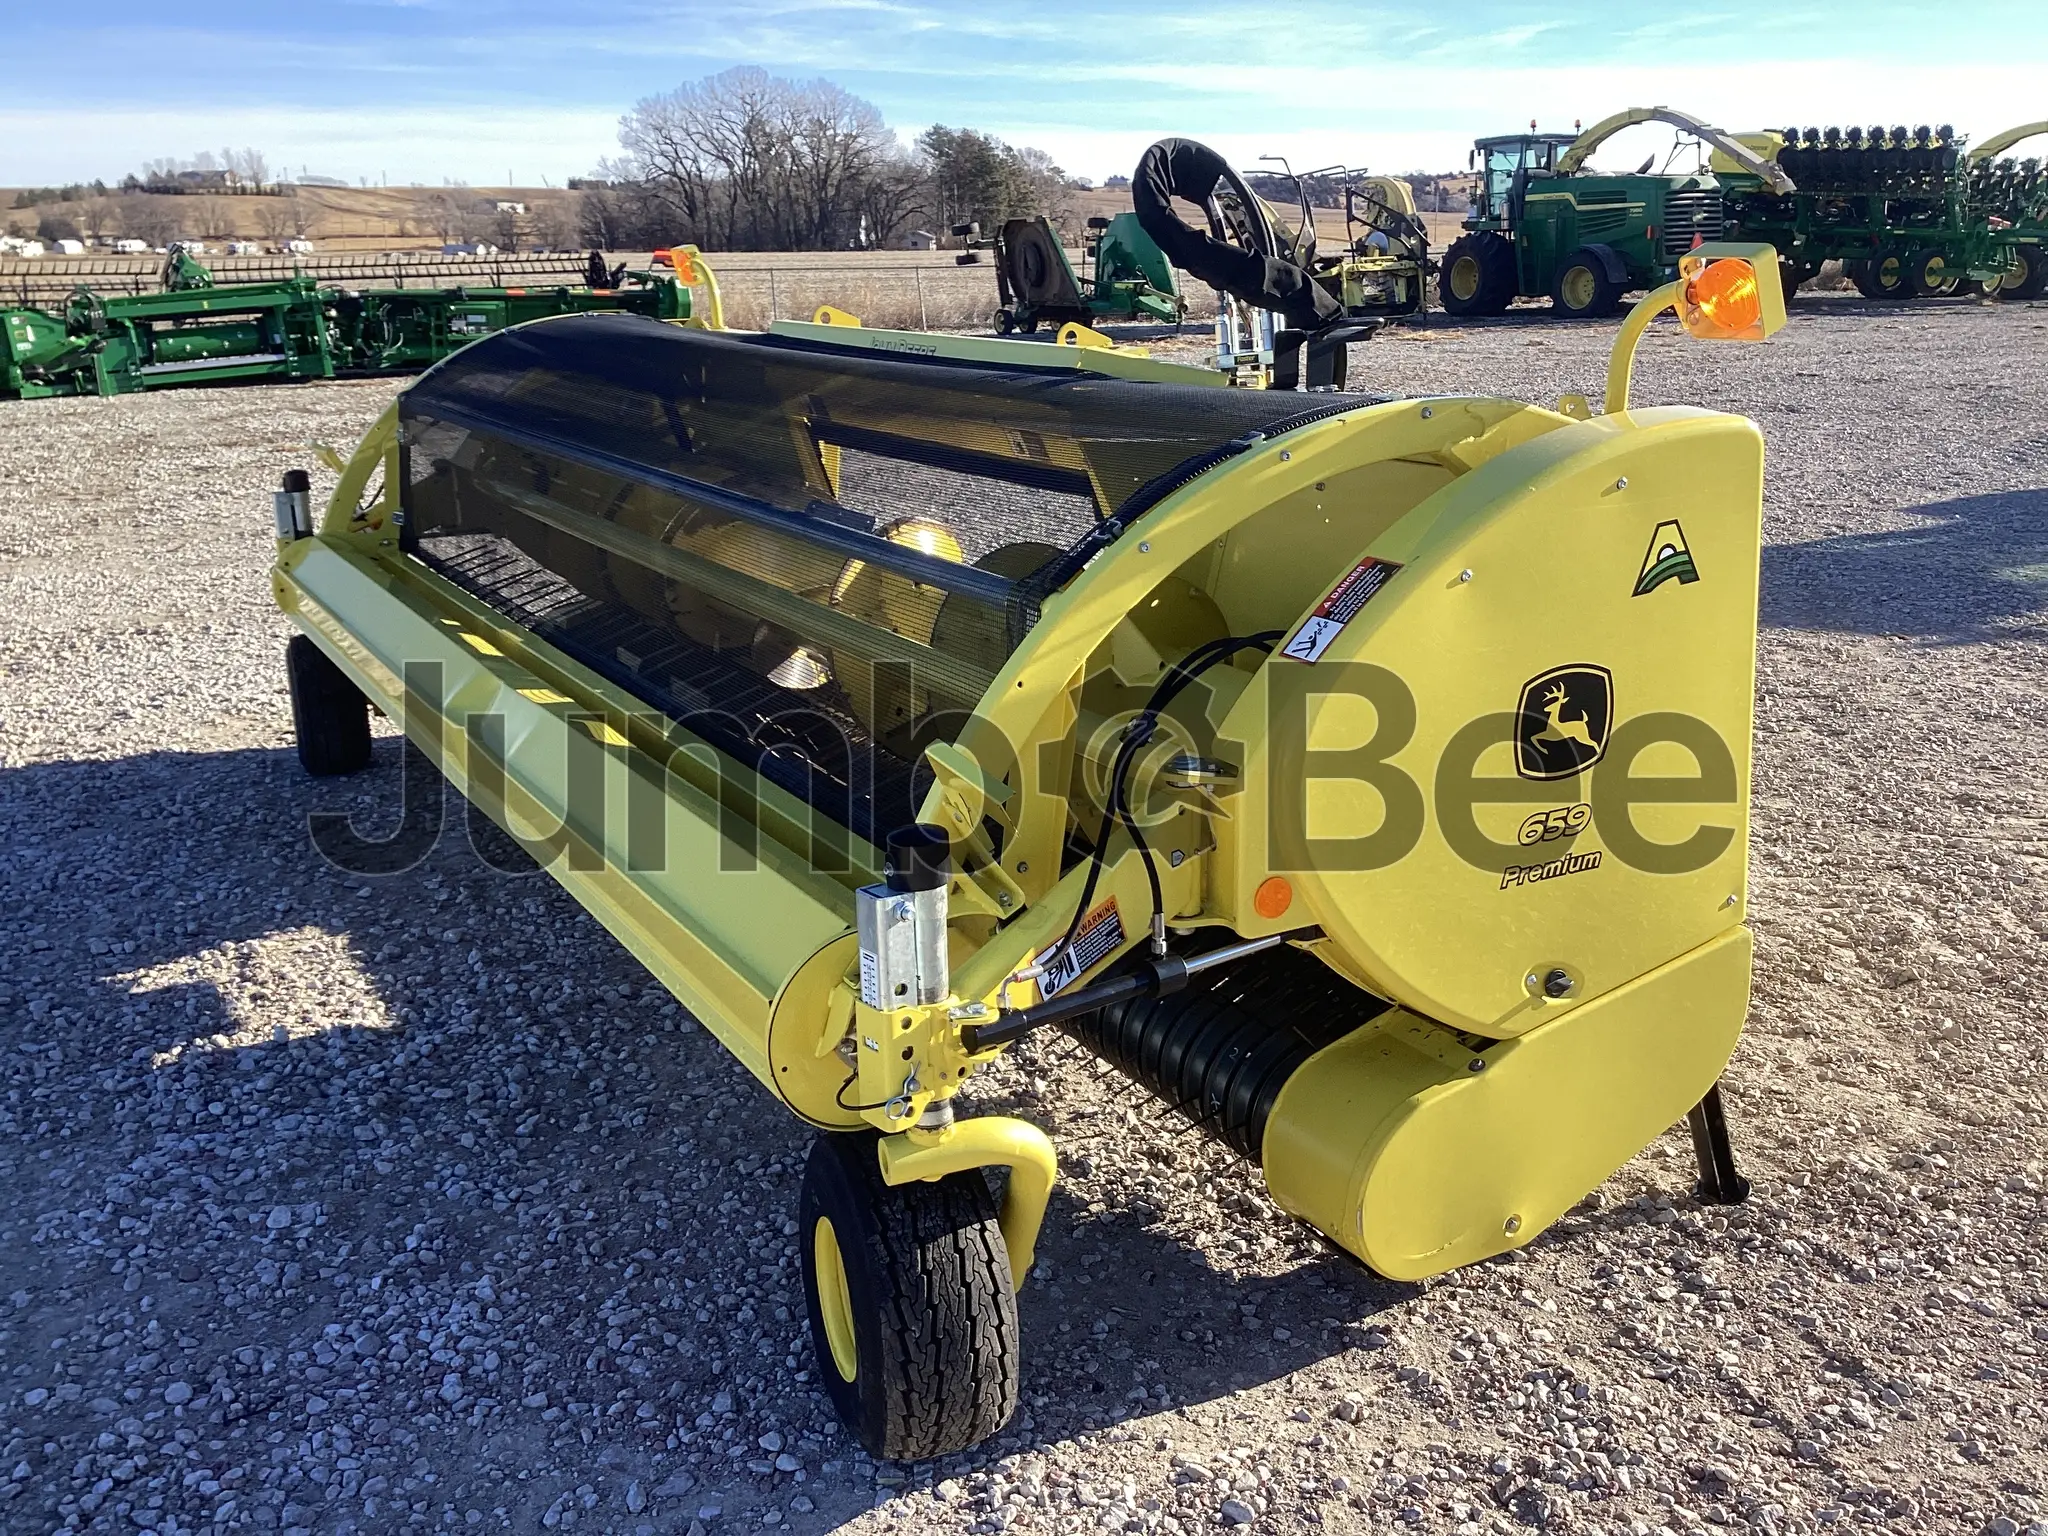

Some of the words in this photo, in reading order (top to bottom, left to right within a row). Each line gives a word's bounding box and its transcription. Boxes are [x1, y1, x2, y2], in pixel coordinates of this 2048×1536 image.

[1330, 565, 1366, 599] DANGER
[1517, 803, 1592, 847] 659
[1499, 851, 1602, 890] Premium
[1081, 901, 1116, 933] WARNING
